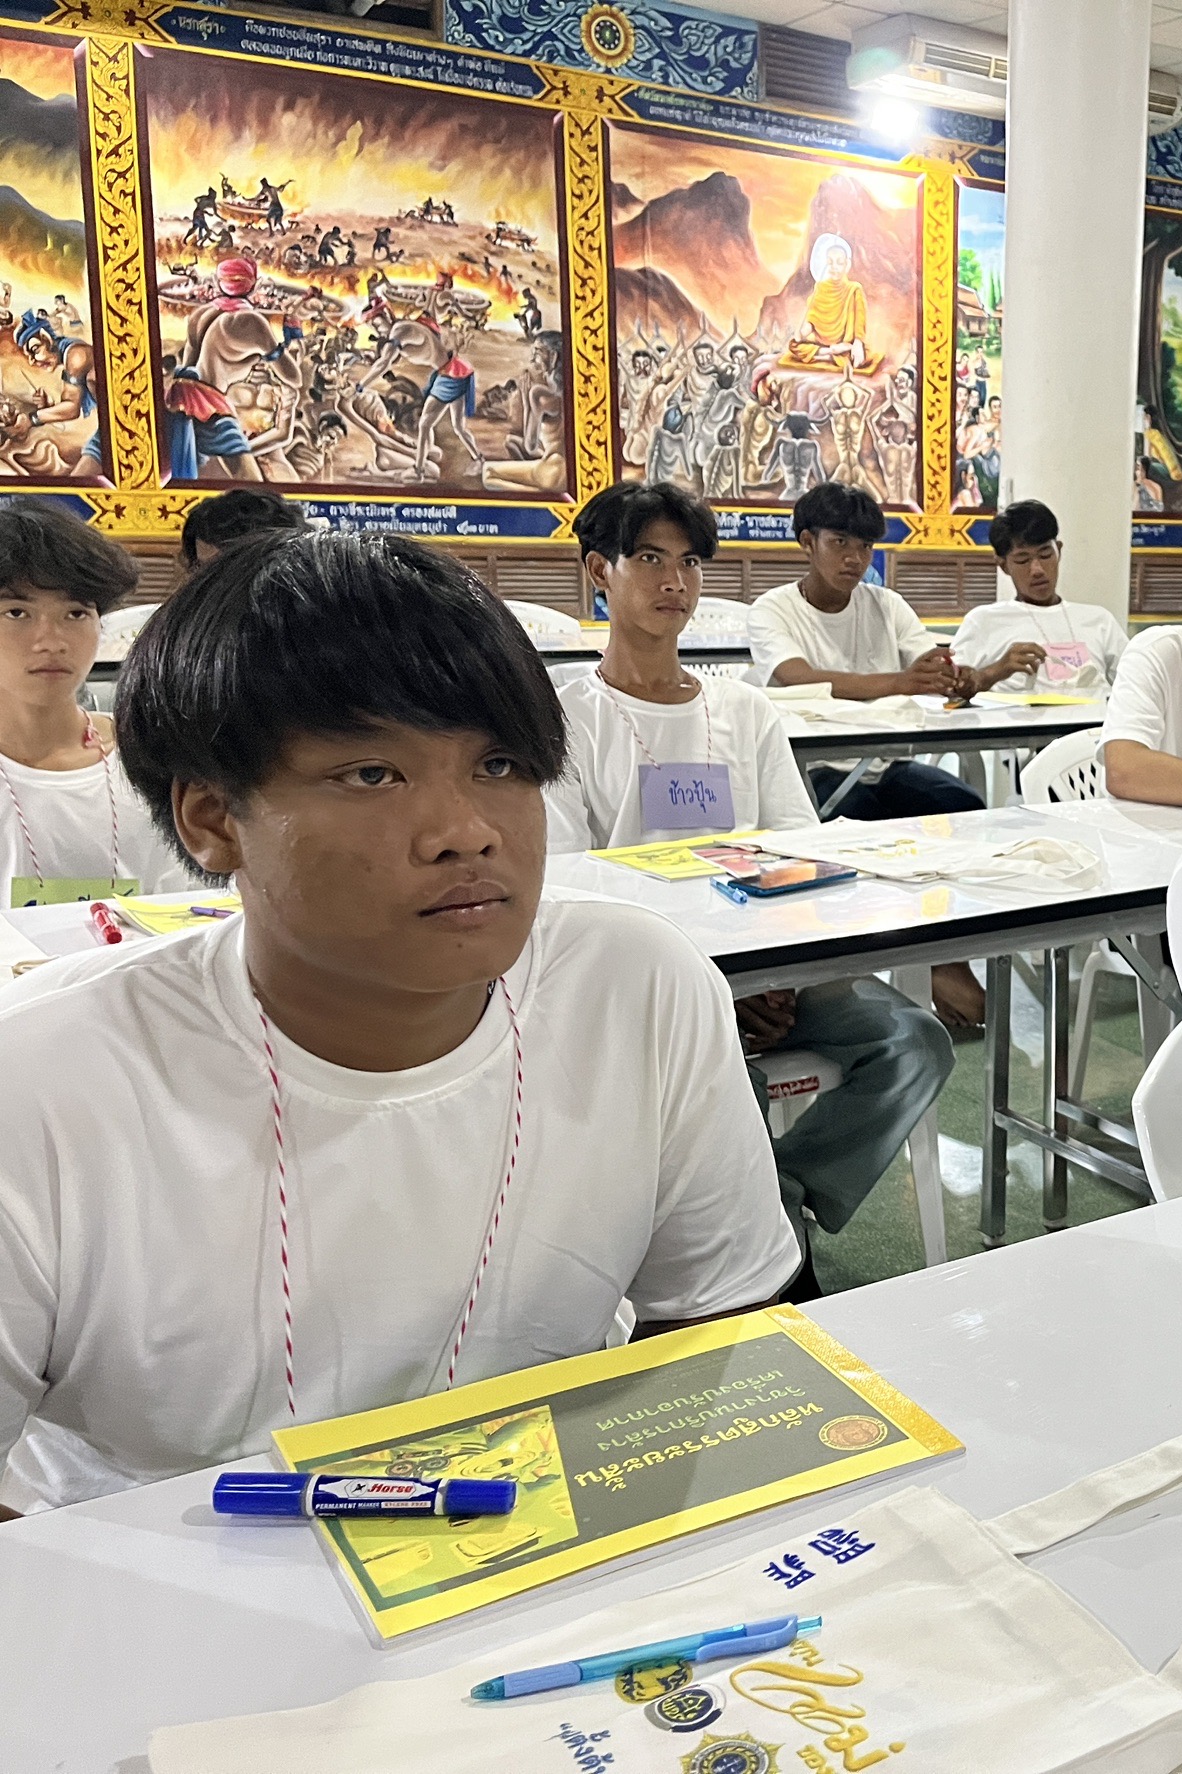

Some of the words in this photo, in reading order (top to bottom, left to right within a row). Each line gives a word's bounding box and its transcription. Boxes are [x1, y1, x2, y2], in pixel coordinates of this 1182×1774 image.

[596, 1369, 784, 1432] เครื่องปรับอากาศ
[597, 1385, 806, 1452] วิชางานบริการล้าง
[573, 1401, 824, 1493] หลักสูตรระยะสั้น
[315, 1502, 357, 1510] PERMANENT
[368, 1483, 414, 1494] Horse
